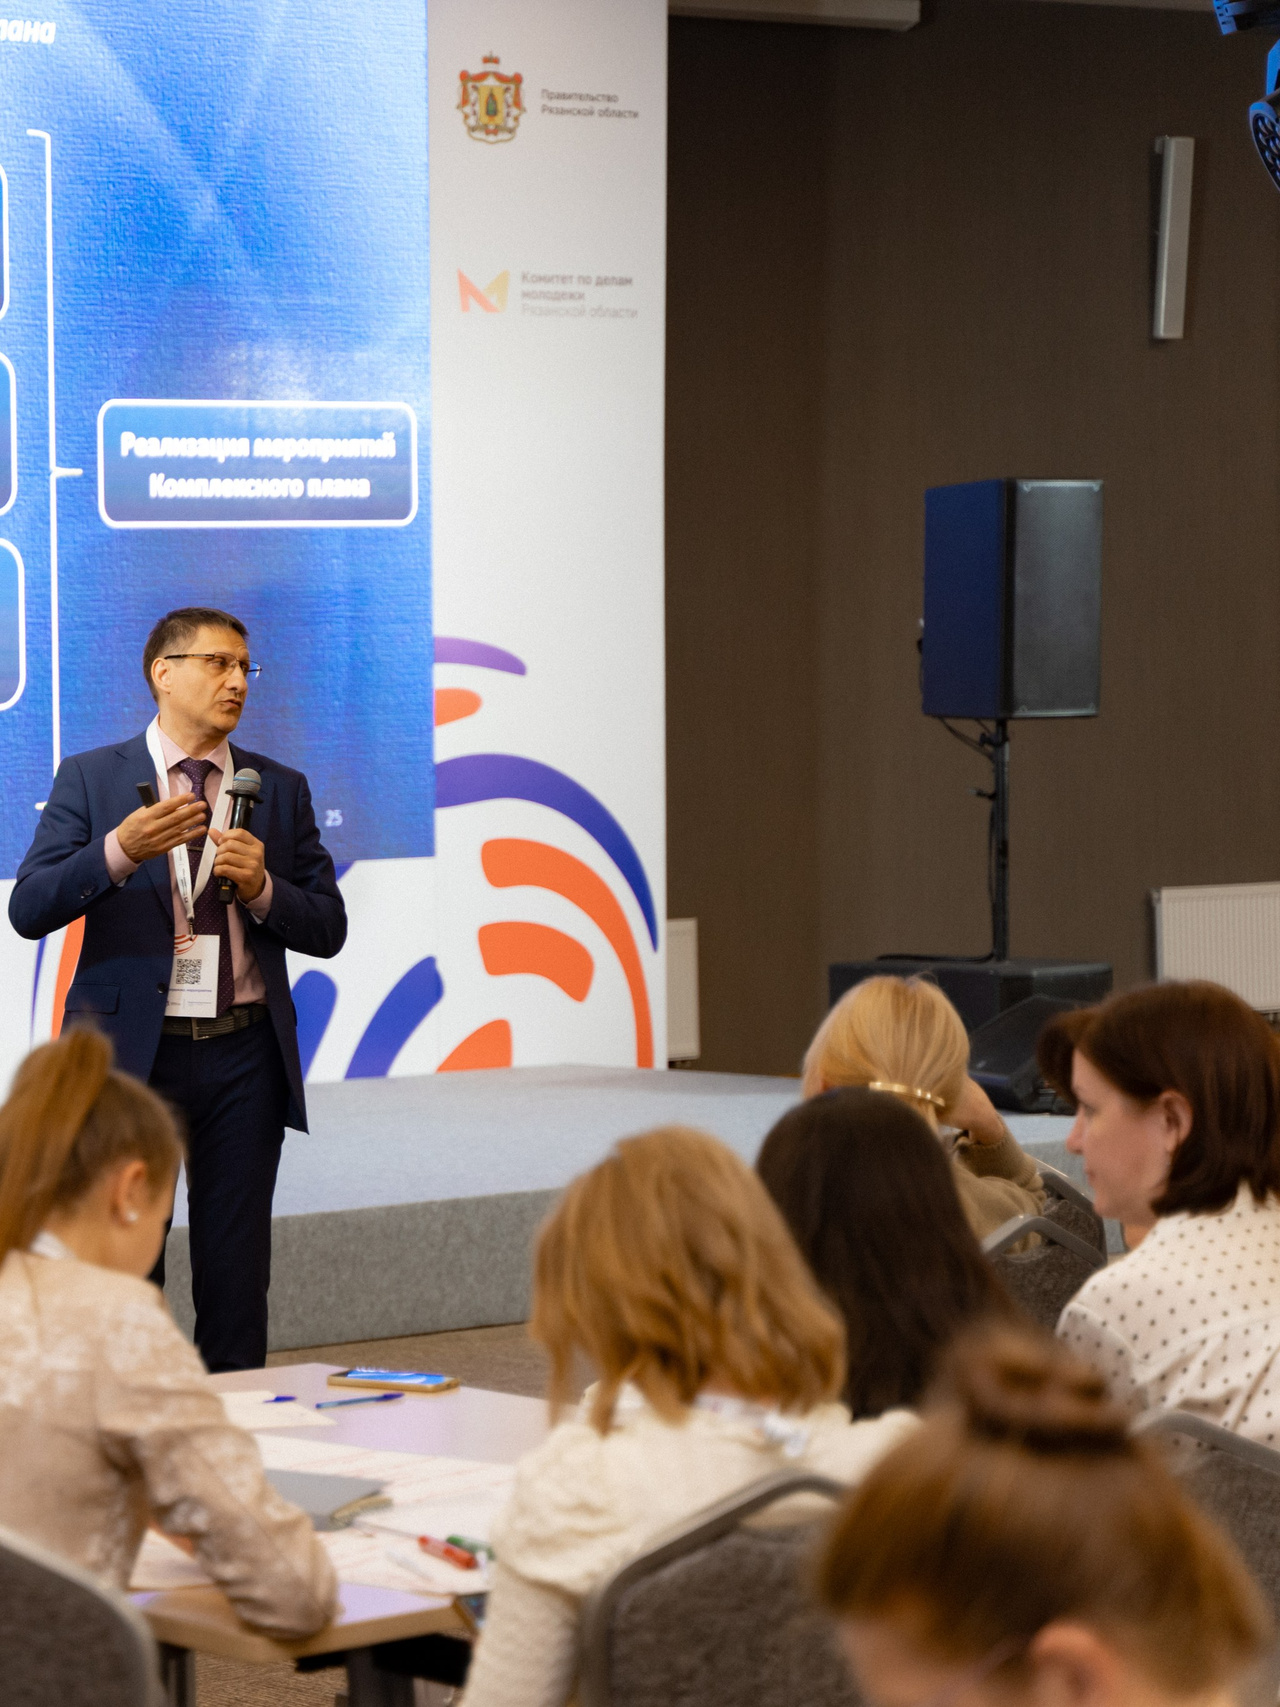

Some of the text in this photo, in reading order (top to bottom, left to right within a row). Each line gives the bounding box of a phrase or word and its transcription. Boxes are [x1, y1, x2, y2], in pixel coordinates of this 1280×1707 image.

[541, 88, 619, 103] Правительство
[120, 431, 397, 464] Реализация мероприятий
[149, 472, 371, 498] Комплексного плана
